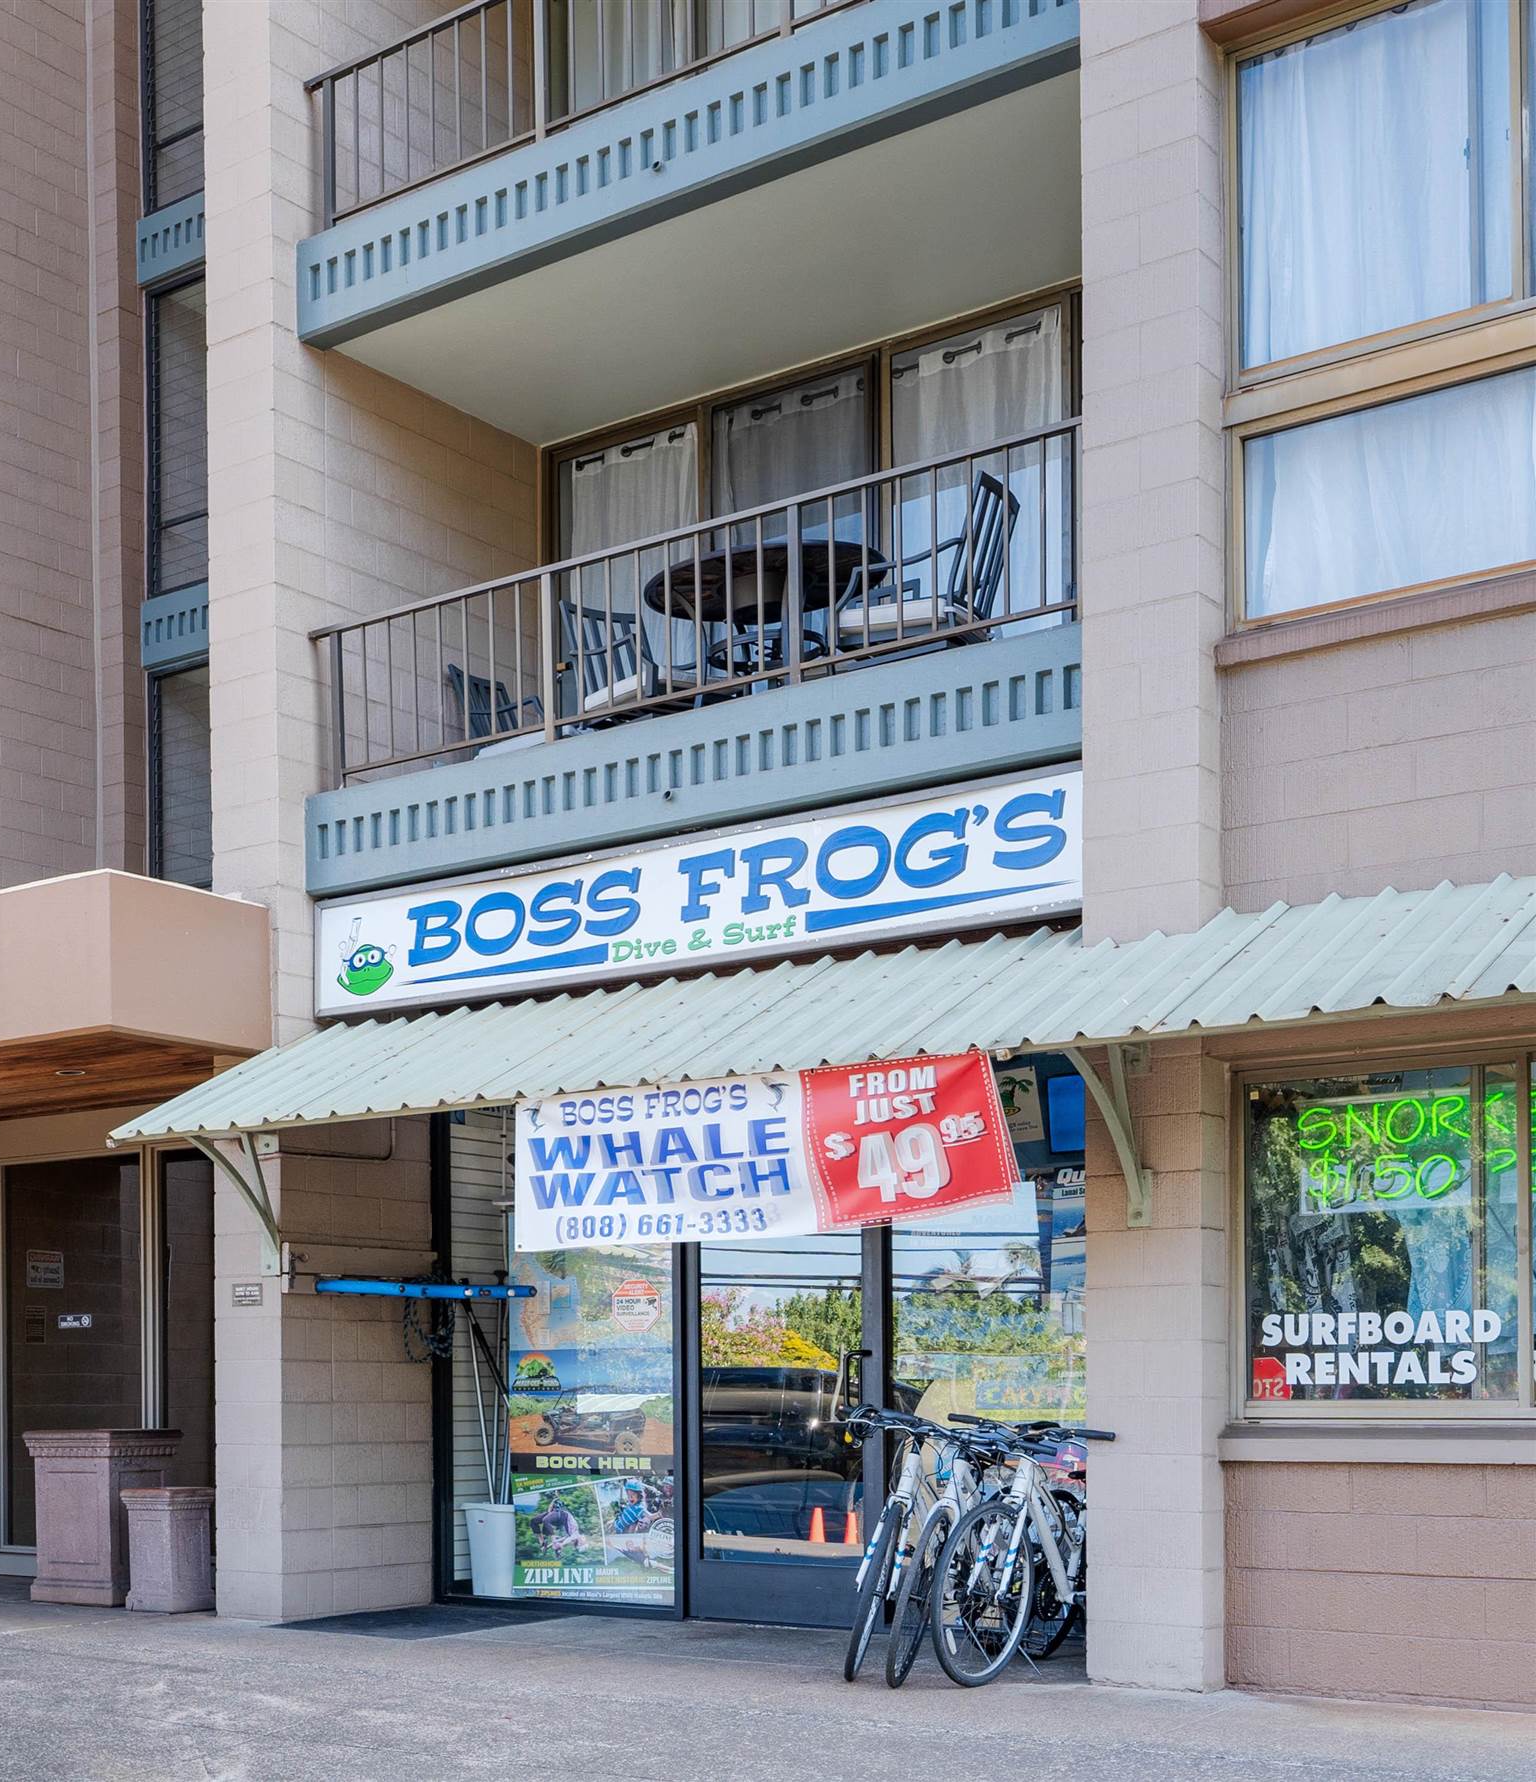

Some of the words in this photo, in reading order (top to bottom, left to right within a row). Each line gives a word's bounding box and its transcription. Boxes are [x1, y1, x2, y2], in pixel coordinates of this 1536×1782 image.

[407, 866, 642, 967] BOSS
[679, 788, 1068, 924] FROG'S
[611, 935, 680, 963] Dive
[687, 928, 712, 950] &
[721, 914, 796, 944] Surf
[849, 1065, 938, 1097] FROM
[559, 1095, 634, 1127] BOSS
[644, 1084, 748, 1119] FROG'S
[854, 1092, 936, 1126] JUST
[527, 1117, 790, 1172] WHALE
[529, 1158, 791, 1210] WATCH
[555, 1213, 627, 1244] (808)
[637, 1208, 768, 1236] 661-3333
[1262, 1310, 1502, 1347] SURFBOARD
[1286, 1351, 1477, 1385] RENTALS
[535, 1456, 591, 1469] BOOK
[598, 1457, 652, 1470] HERE
[524, 1568, 594, 1584] ZIPLINE
[646, 1576, 673, 1584] ZIPLINE
